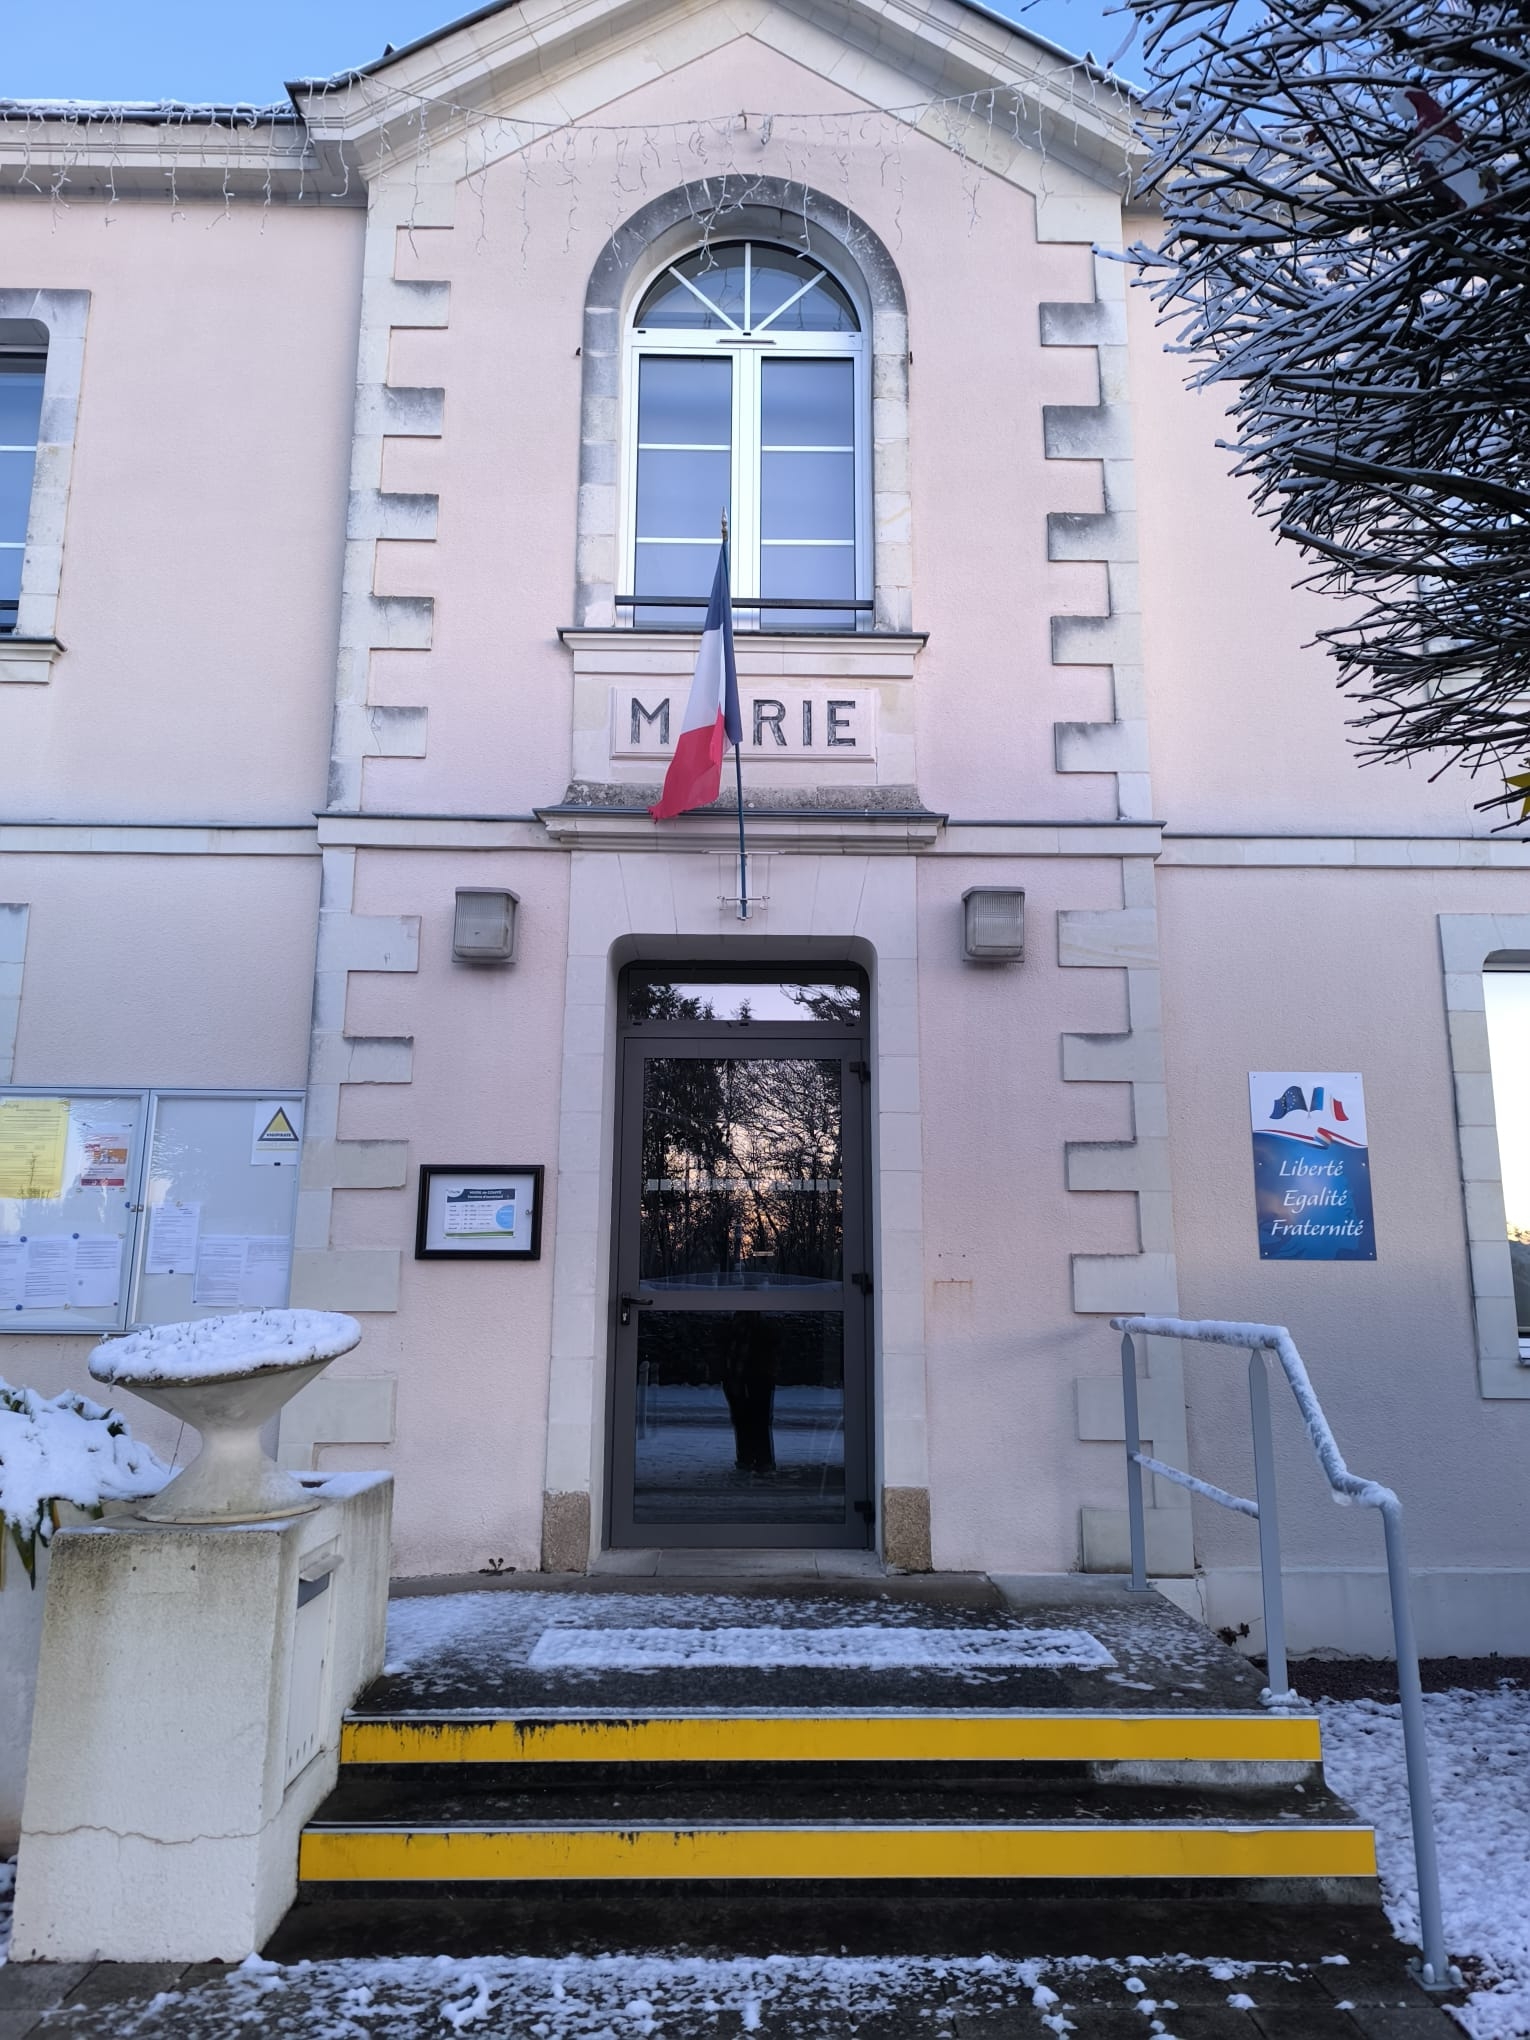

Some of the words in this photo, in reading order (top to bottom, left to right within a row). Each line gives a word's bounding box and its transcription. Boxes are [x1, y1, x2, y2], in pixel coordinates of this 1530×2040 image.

[631, 698, 856, 747] MRIE
[1279, 1157, 1344, 1177] Liberté
[1283, 1187, 1348, 1214] Egalité
[1271, 1219, 1364, 1236] Fraternité
